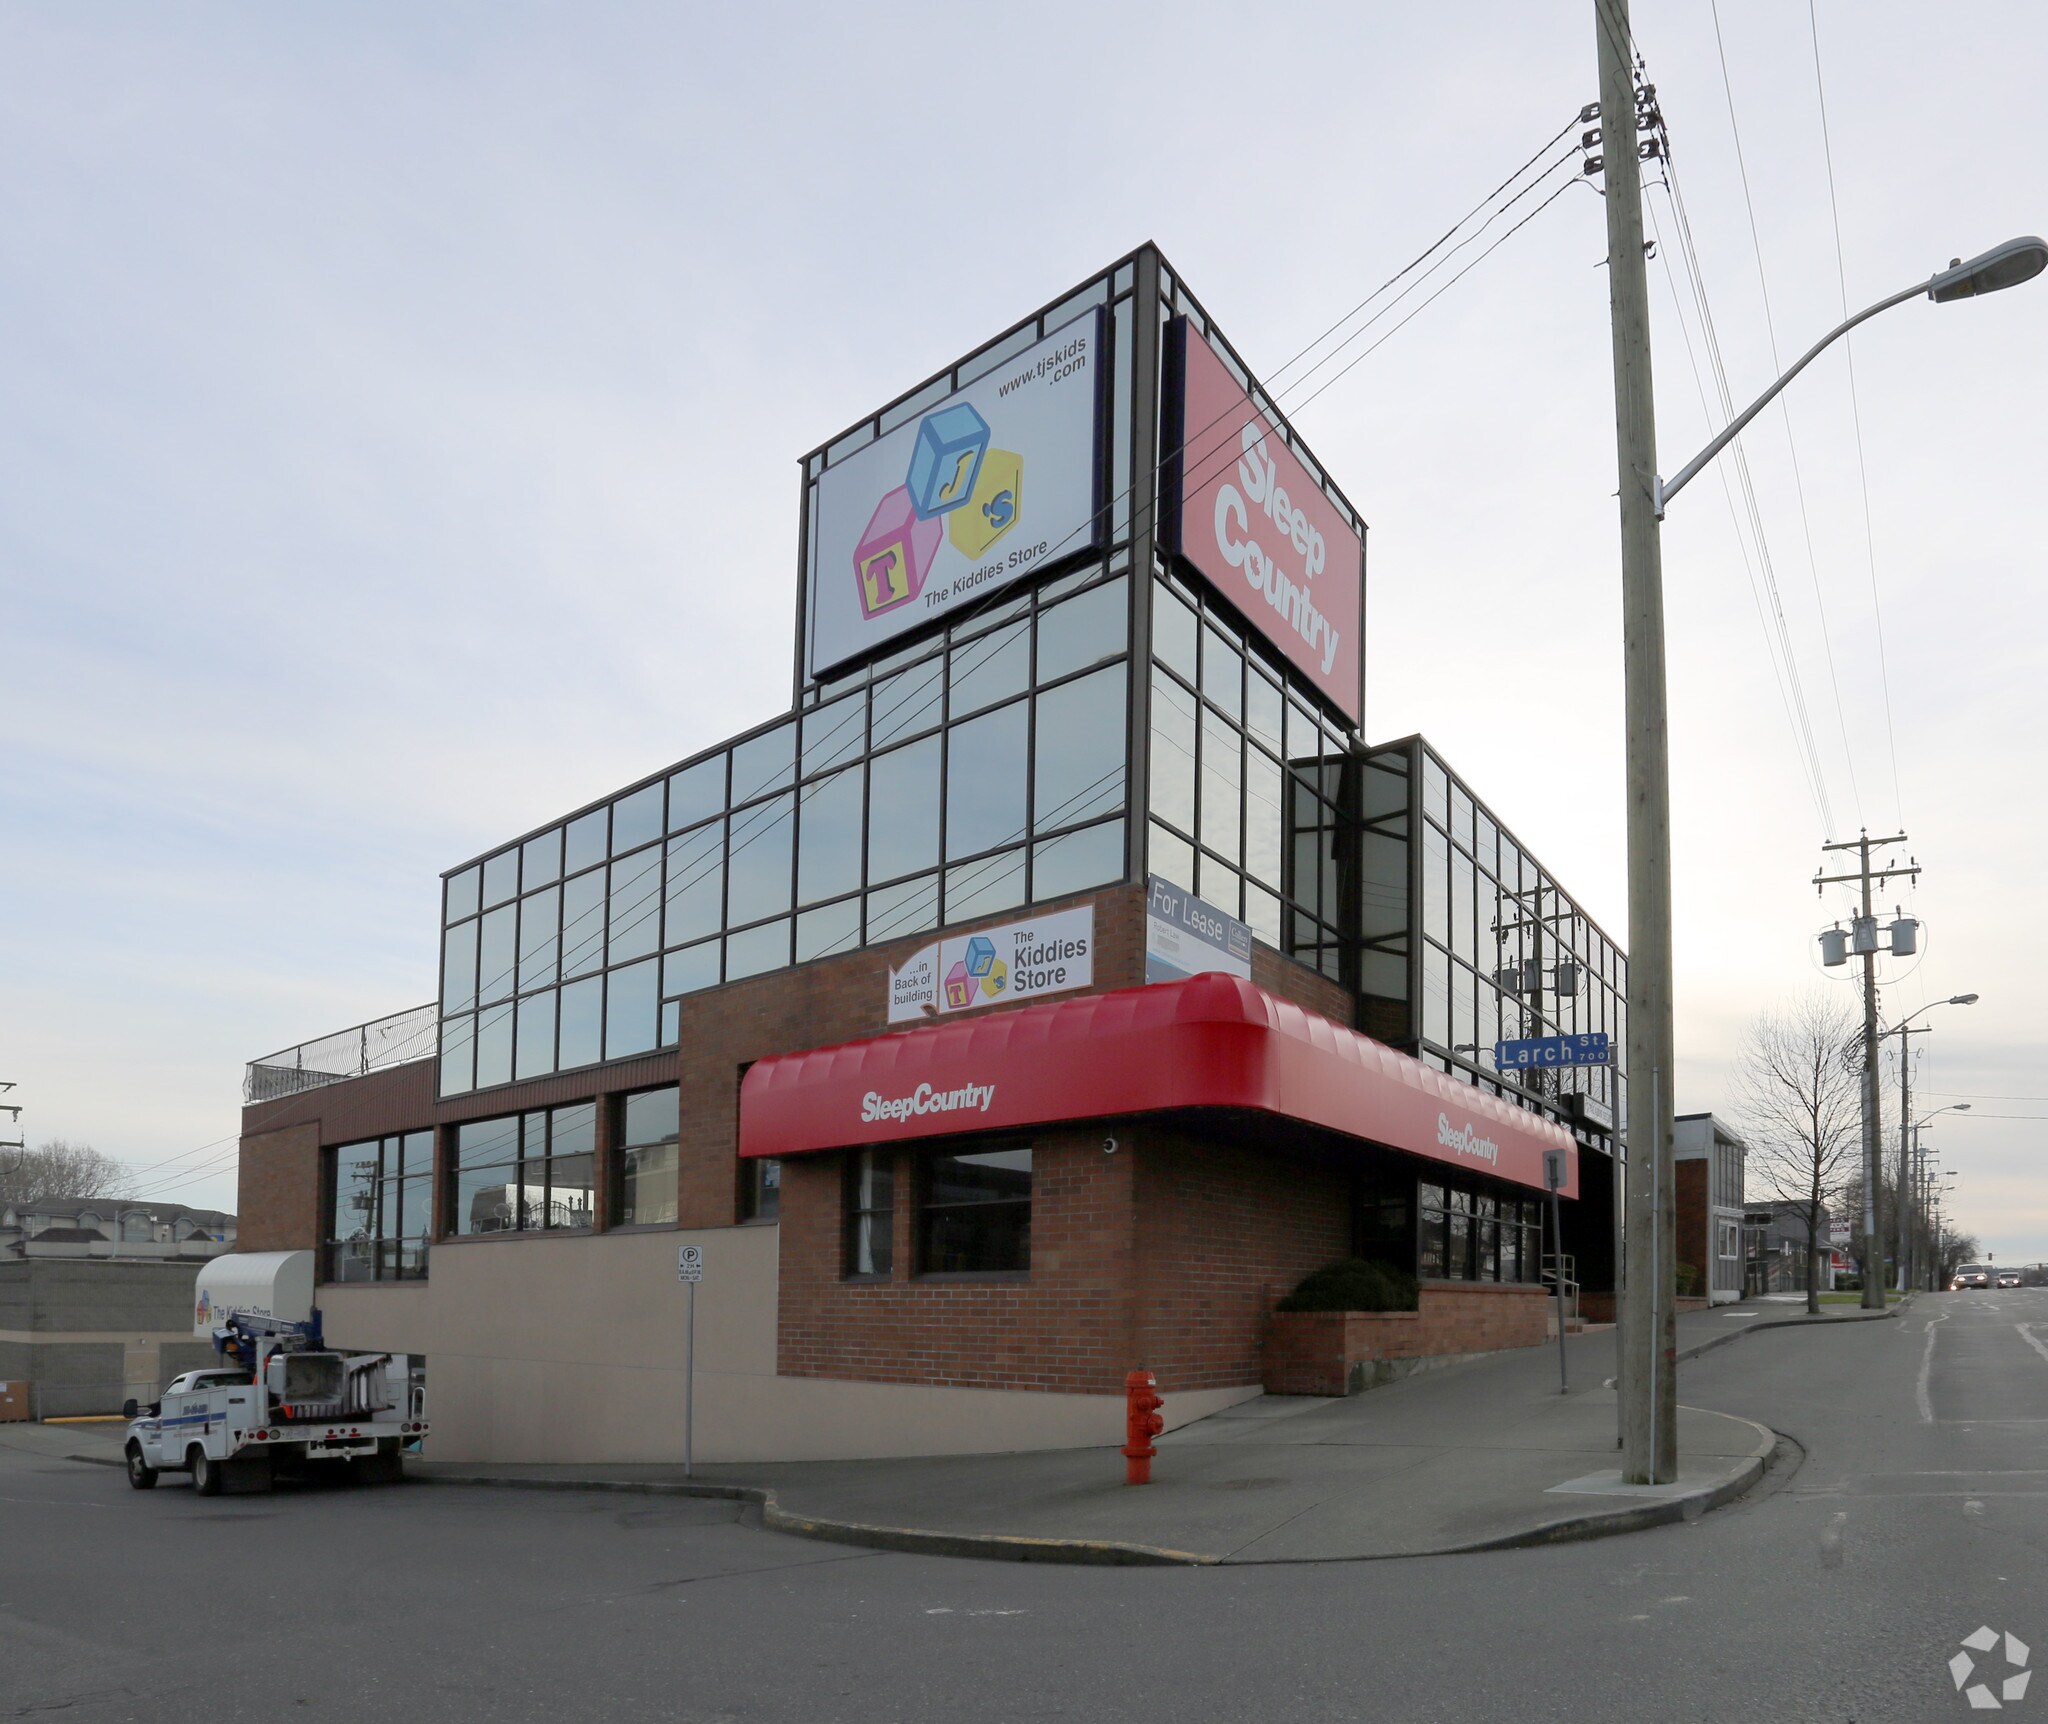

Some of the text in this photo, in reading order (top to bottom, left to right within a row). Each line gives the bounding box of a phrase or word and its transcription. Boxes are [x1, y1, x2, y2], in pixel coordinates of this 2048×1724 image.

[998, 338, 1087, 398] www.tjskids
[1049, 355, 1086, 386] .com
[1238, 420, 1326, 580] Sleep
[866, 550, 897, 605] T
[939, 450, 975, 501] J
[924, 540, 1048, 608] The Kiddies Store
[1214, 483, 1340, 676] Country
[1152, 881, 1223, 941] For Lease
[1013, 930, 1034, 945] The
[1014, 938, 1087, 970] Kiddies
[894, 972, 932, 991] Back of
[949, 985, 962, 1004] T
[976, 955, 990, 972] J
[1014, 966, 1067, 992] Store
[894, 989, 933, 1005] building
[1501, 1035, 1605, 1065] Larch St.
[1580, 1052, 1605, 1061] 700
[860, 1082, 995, 1123] SleepCountry
[213, 1305, 225, 1320] The
